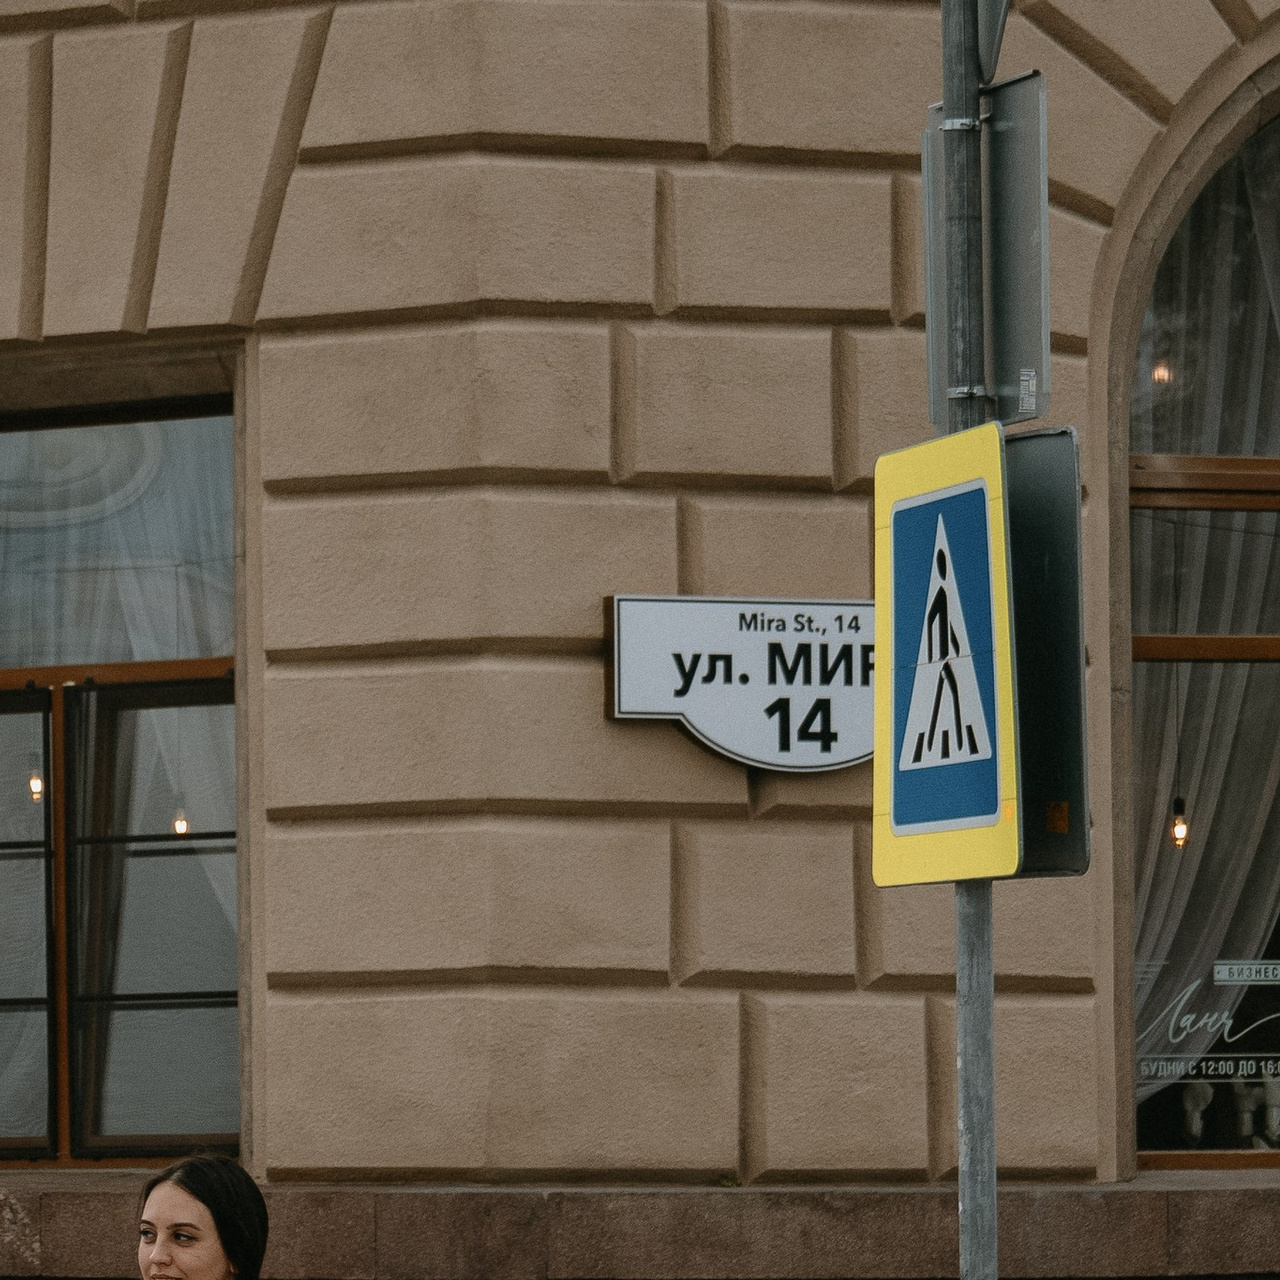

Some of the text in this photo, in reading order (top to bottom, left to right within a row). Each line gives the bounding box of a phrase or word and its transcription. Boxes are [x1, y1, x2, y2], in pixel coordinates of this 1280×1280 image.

[739, 612, 861, 635] Mira St., 14
[672, 642, 875, 697] ул. МИР
[763, 697, 838, 753] 14
[1228, 967, 1280, 979] БИЗНЕС
[1140, 1061, 1185, 1077] БУДНИ
[1188, 1061, 1197, 1075] С
[1200, 1061, 1234, 1075] 12:00
[1237, 1060, 1256, 1077] ДО
